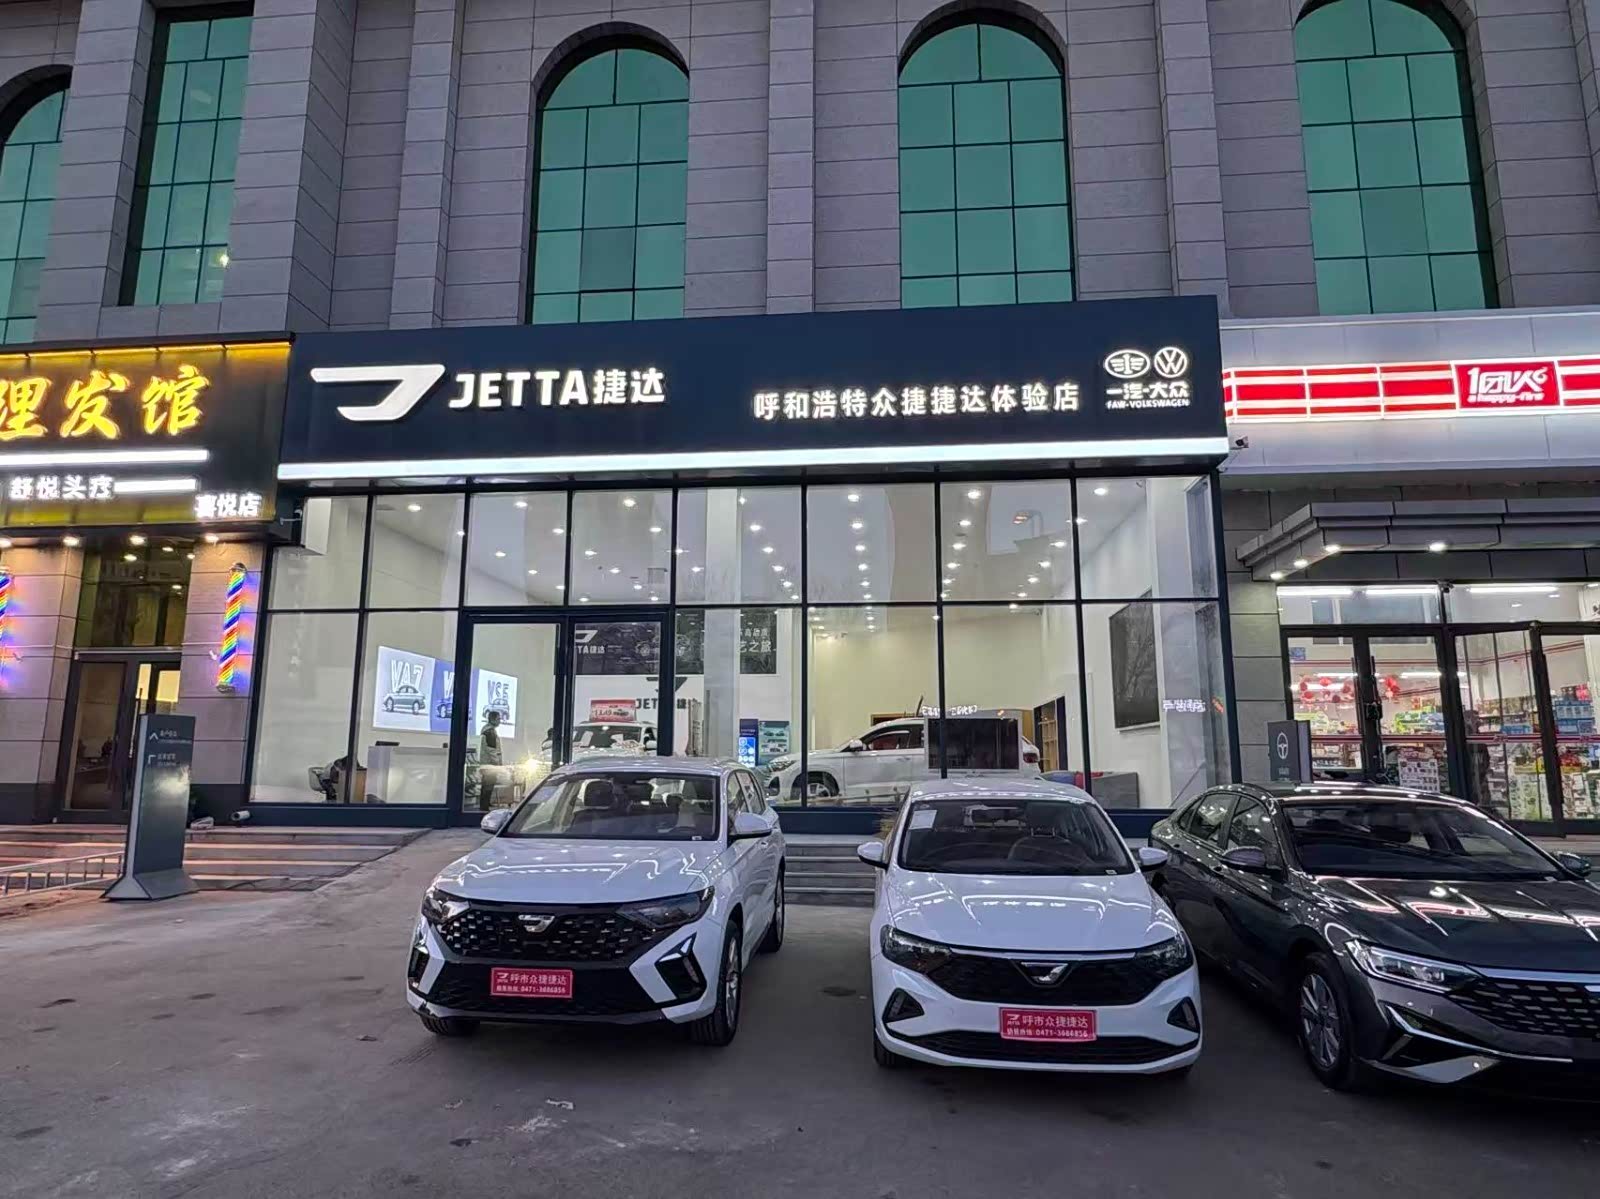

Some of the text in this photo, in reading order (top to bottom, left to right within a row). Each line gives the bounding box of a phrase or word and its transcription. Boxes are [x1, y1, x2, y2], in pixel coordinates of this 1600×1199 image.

[753, 381, 1080, 420] 呼和浩特众捷捷达体验店
